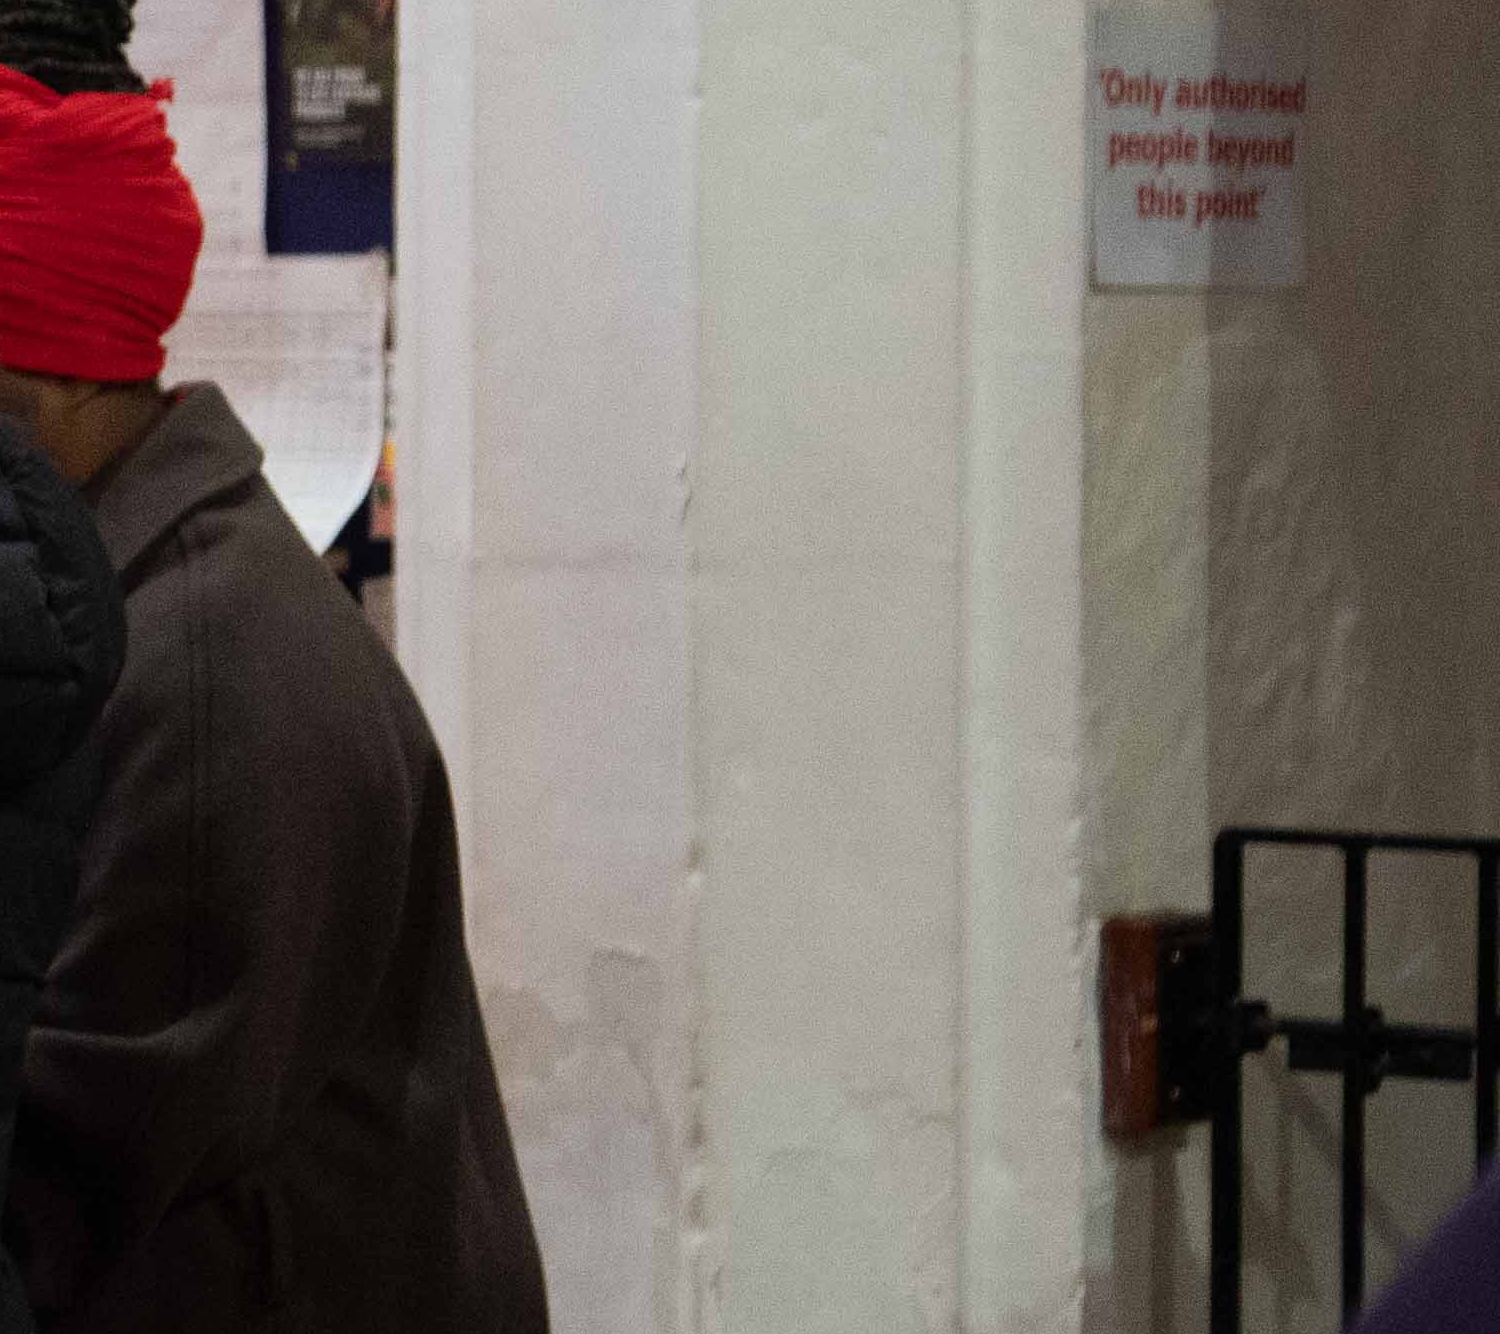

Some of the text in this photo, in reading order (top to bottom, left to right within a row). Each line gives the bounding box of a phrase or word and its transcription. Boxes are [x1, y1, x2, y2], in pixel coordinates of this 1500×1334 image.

[1173, 72, 1308, 113] authorised
[1108, 125, 1295, 174] people beyond
[1135, 181, 1186, 220] this
